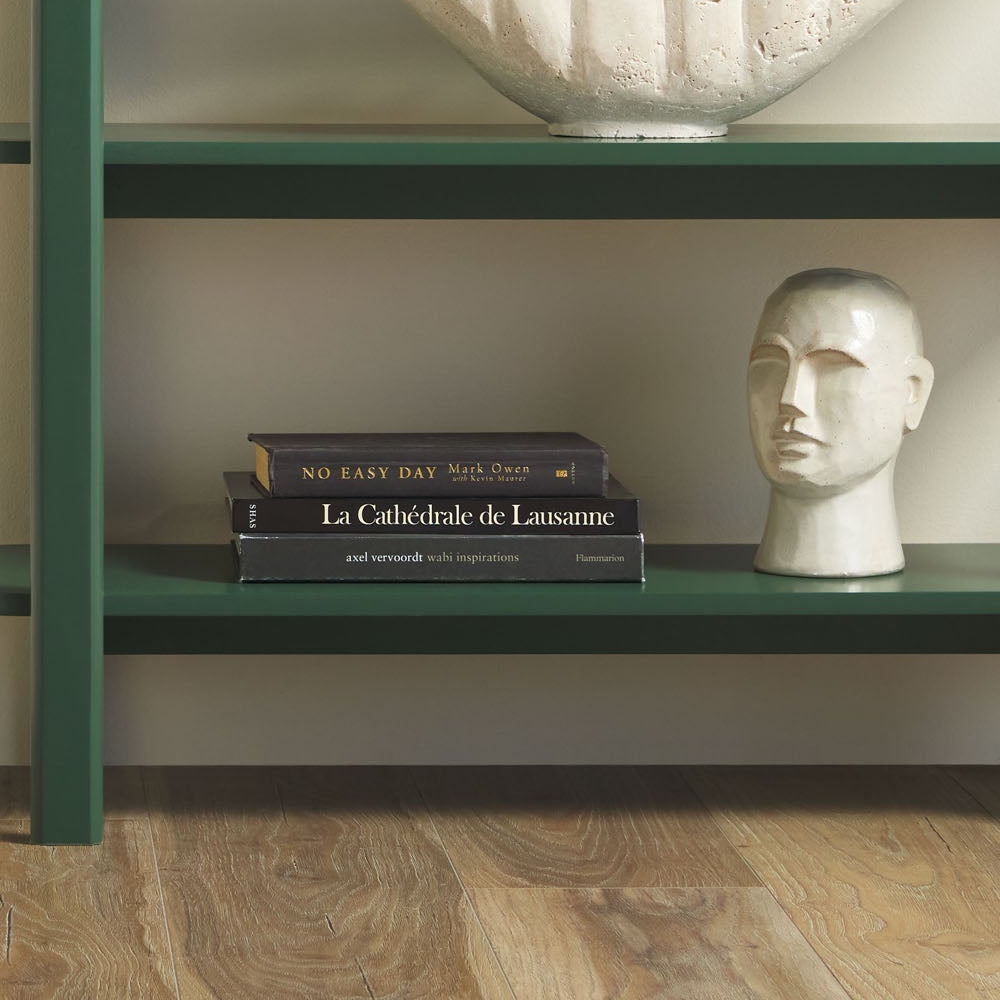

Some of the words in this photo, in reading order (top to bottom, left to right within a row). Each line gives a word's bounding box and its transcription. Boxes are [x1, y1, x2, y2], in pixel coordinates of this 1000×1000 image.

[302, 466, 331, 480] NO
[341, 466, 389, 480] EASY
[399, 466, 437, 480] DAY
[448, 463, 484, 474] Mark
[491, 463, 530, 474] Owen
[321, 503, 351, 525] La
[357, 503, 473, 526] Cathédrale
[479, 504, 506, 526] de
[511, 504, 615, 526] Lausanne
[345, 551, 368, 562] axel
[371, 551, 423, 562] vervoordt
[427, 551, 453, 562] wabi
[456, 551, 519, 565] inspirations
[575, 552, 625, 562] Flammarion
